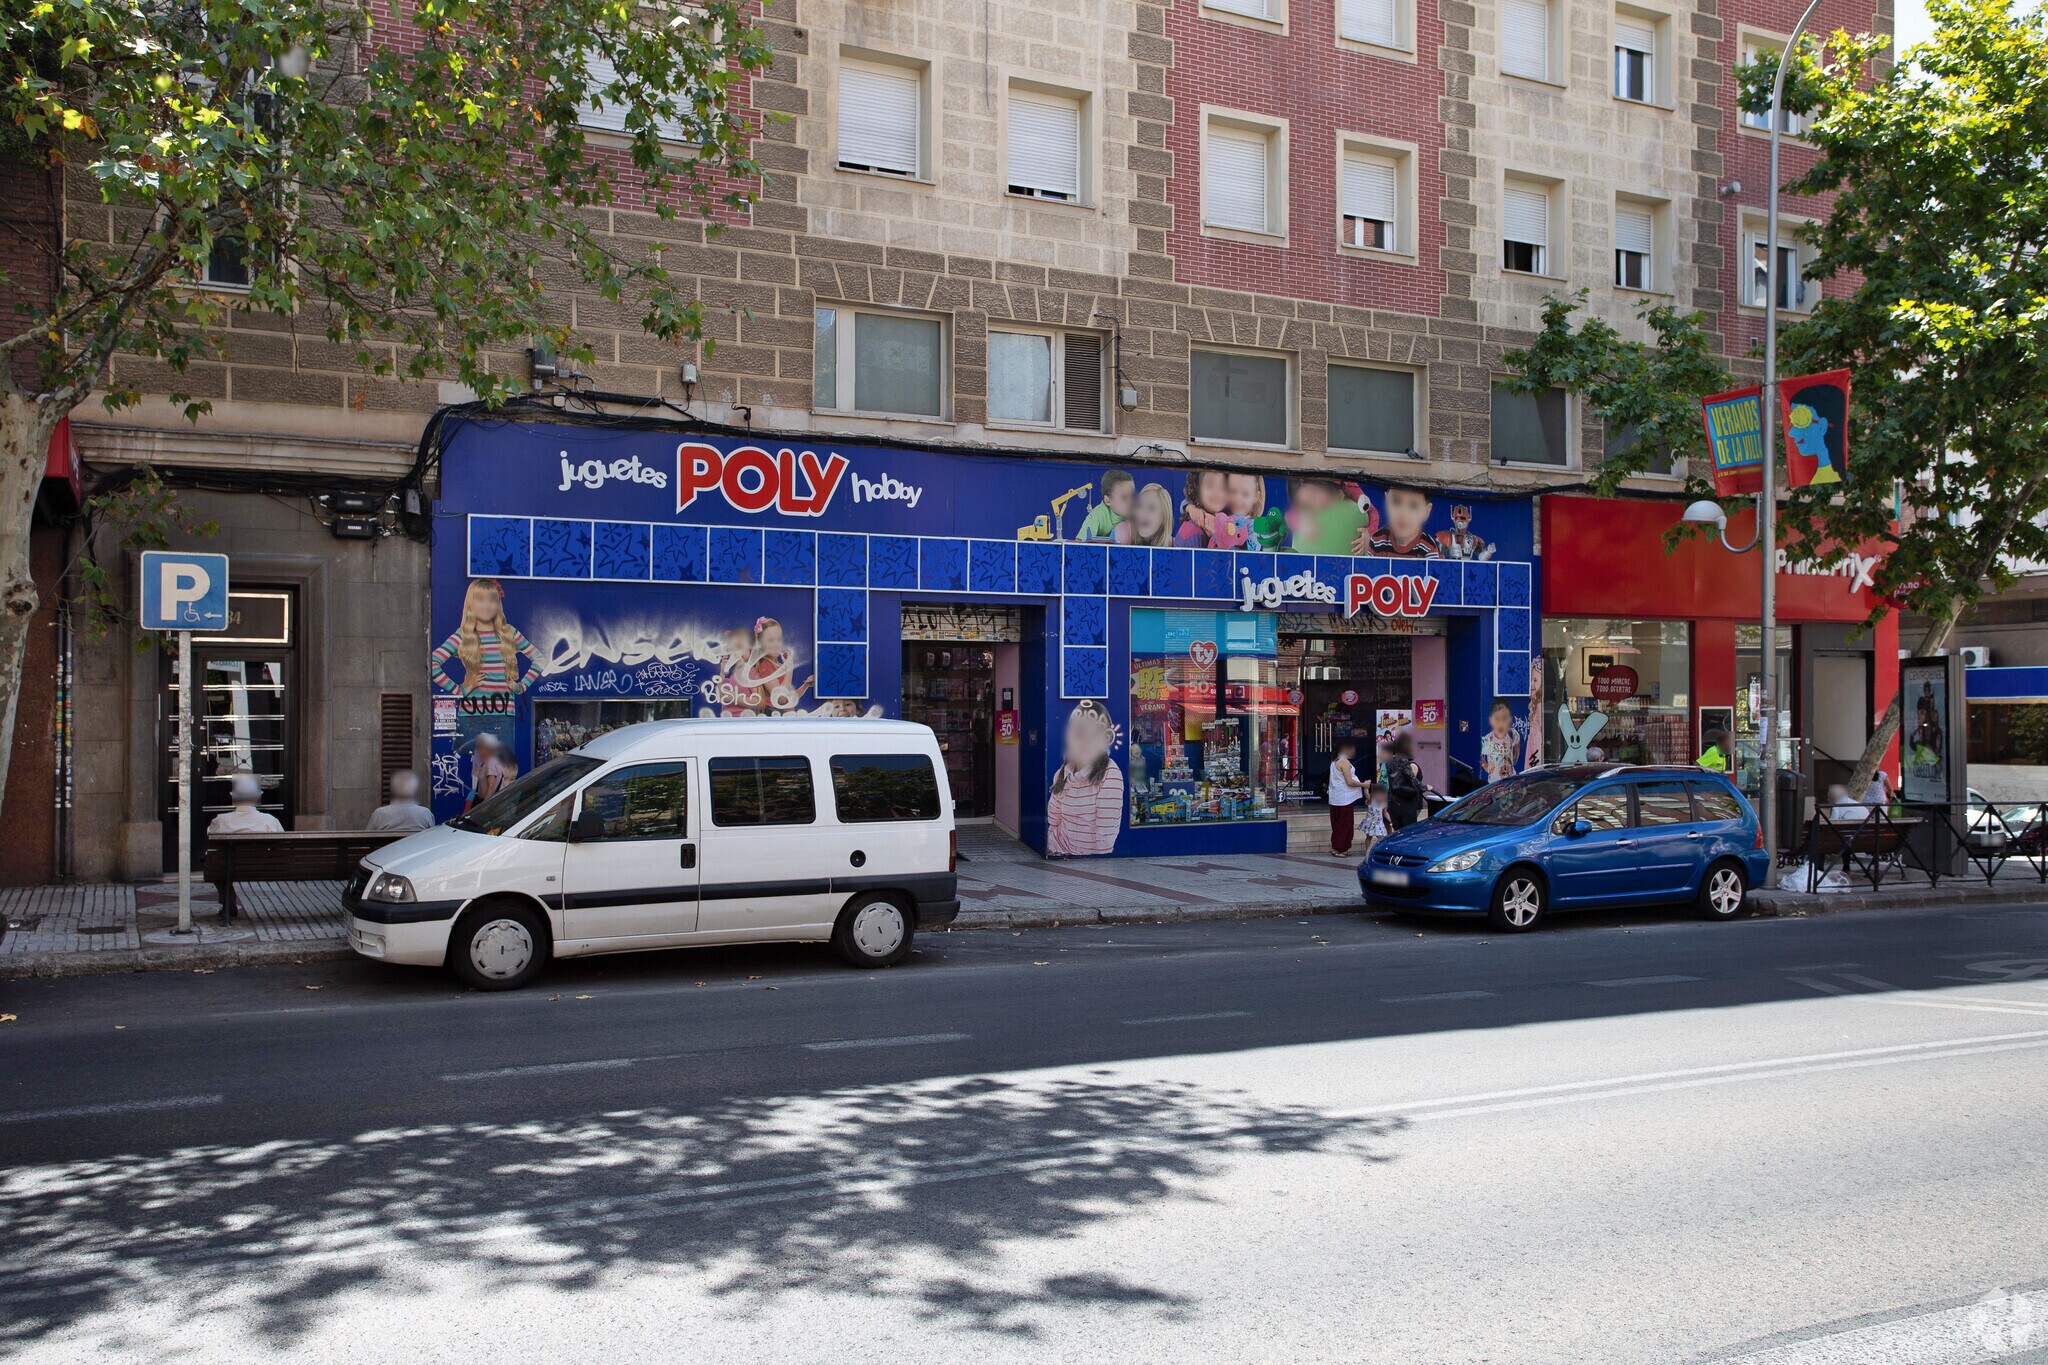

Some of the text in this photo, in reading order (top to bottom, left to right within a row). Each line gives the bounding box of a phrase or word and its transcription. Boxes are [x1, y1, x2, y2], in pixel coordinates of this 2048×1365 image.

[1711, 399, 1760, 437] VERANOS
[1716, 439, 1732, 465] DE
[1732, 435, 1743, 463] LA
[559, 442, 922, 517] juguetes POLY hobby
[161, 563, 211, 621] P
[1239, 567, 1439, 619] juguetes POLY
[1193, 643, 1214, 664] ty
[1139, 668, 1165, 689] RE
